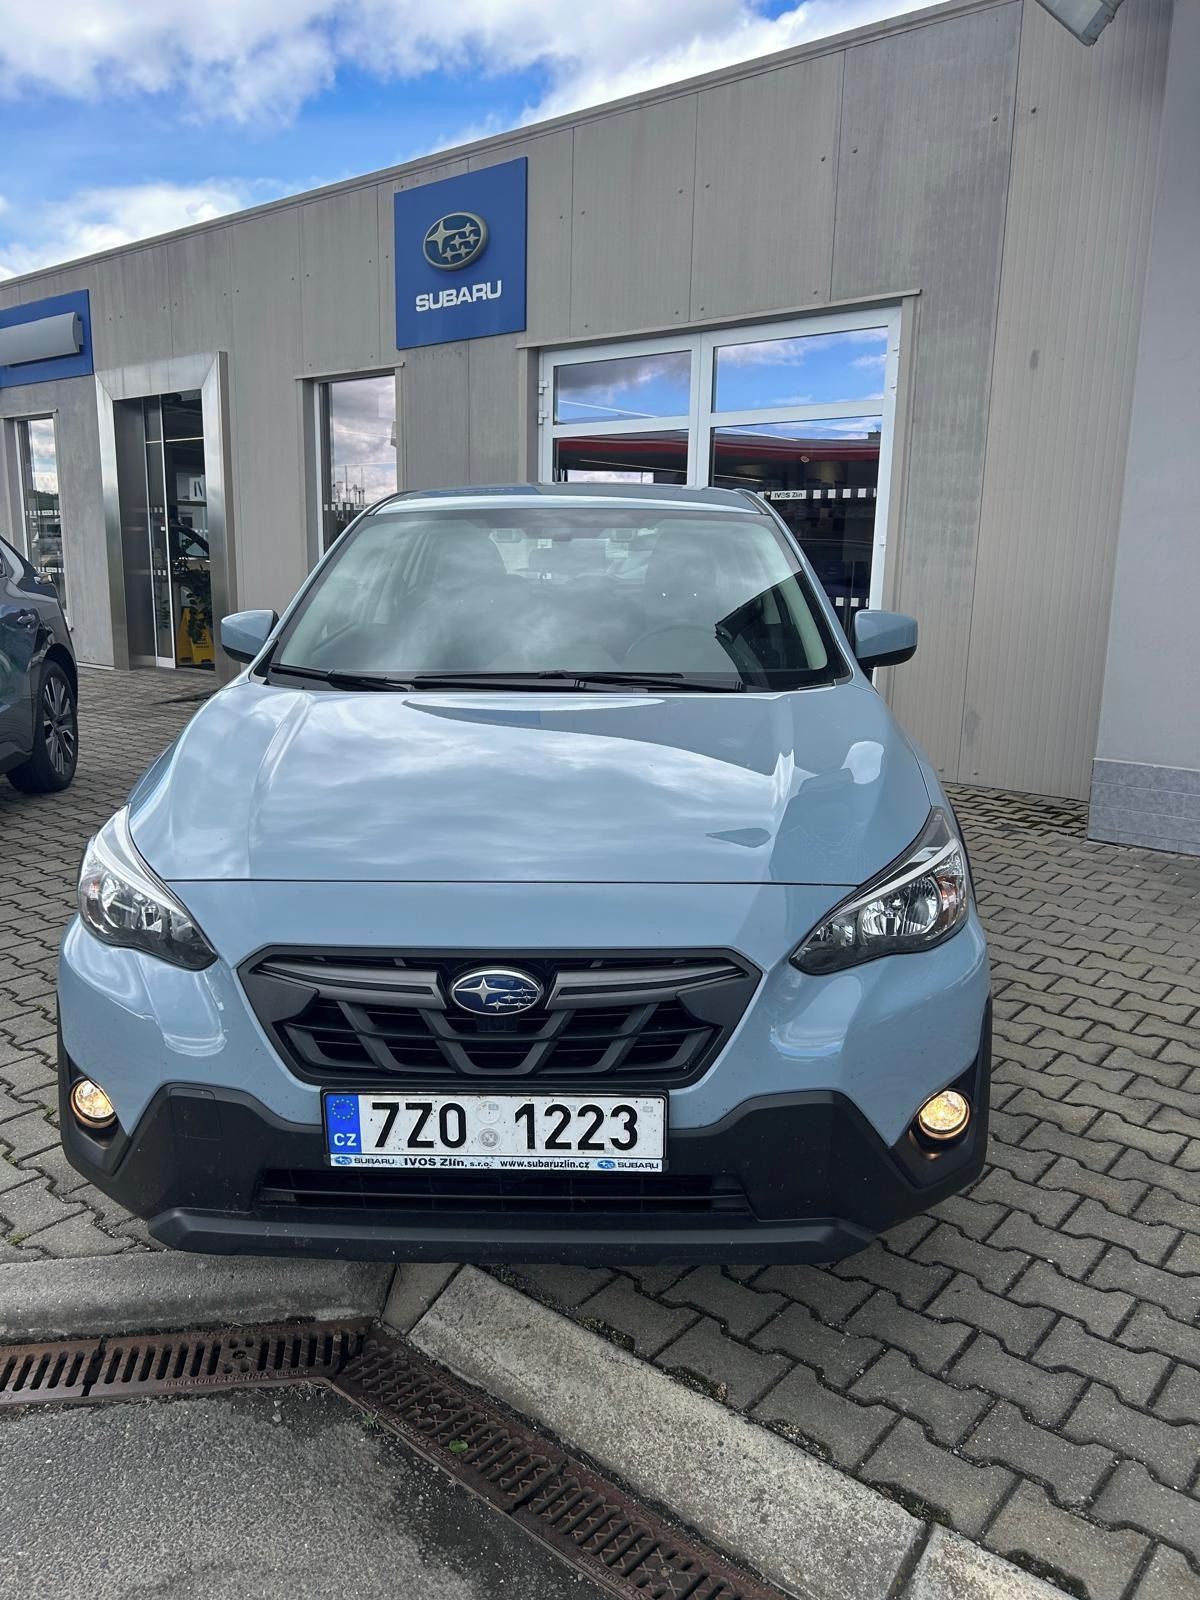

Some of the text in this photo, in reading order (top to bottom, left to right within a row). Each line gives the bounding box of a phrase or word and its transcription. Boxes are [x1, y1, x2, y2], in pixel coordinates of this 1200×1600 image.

[416, 280, 502, 312] SUBARU
[371, 1102, 638, 1151] 7Z0 1223
[333, 1133, 357, 1146] CZ
[354, 1157, 395, 1165] SUBARU
[404, 1157, 437, 1167] IVOS
[500, 1160, 590, 1169] www.subaruzlin.cz
[617, 1161, 659, 1169] SUBARU
